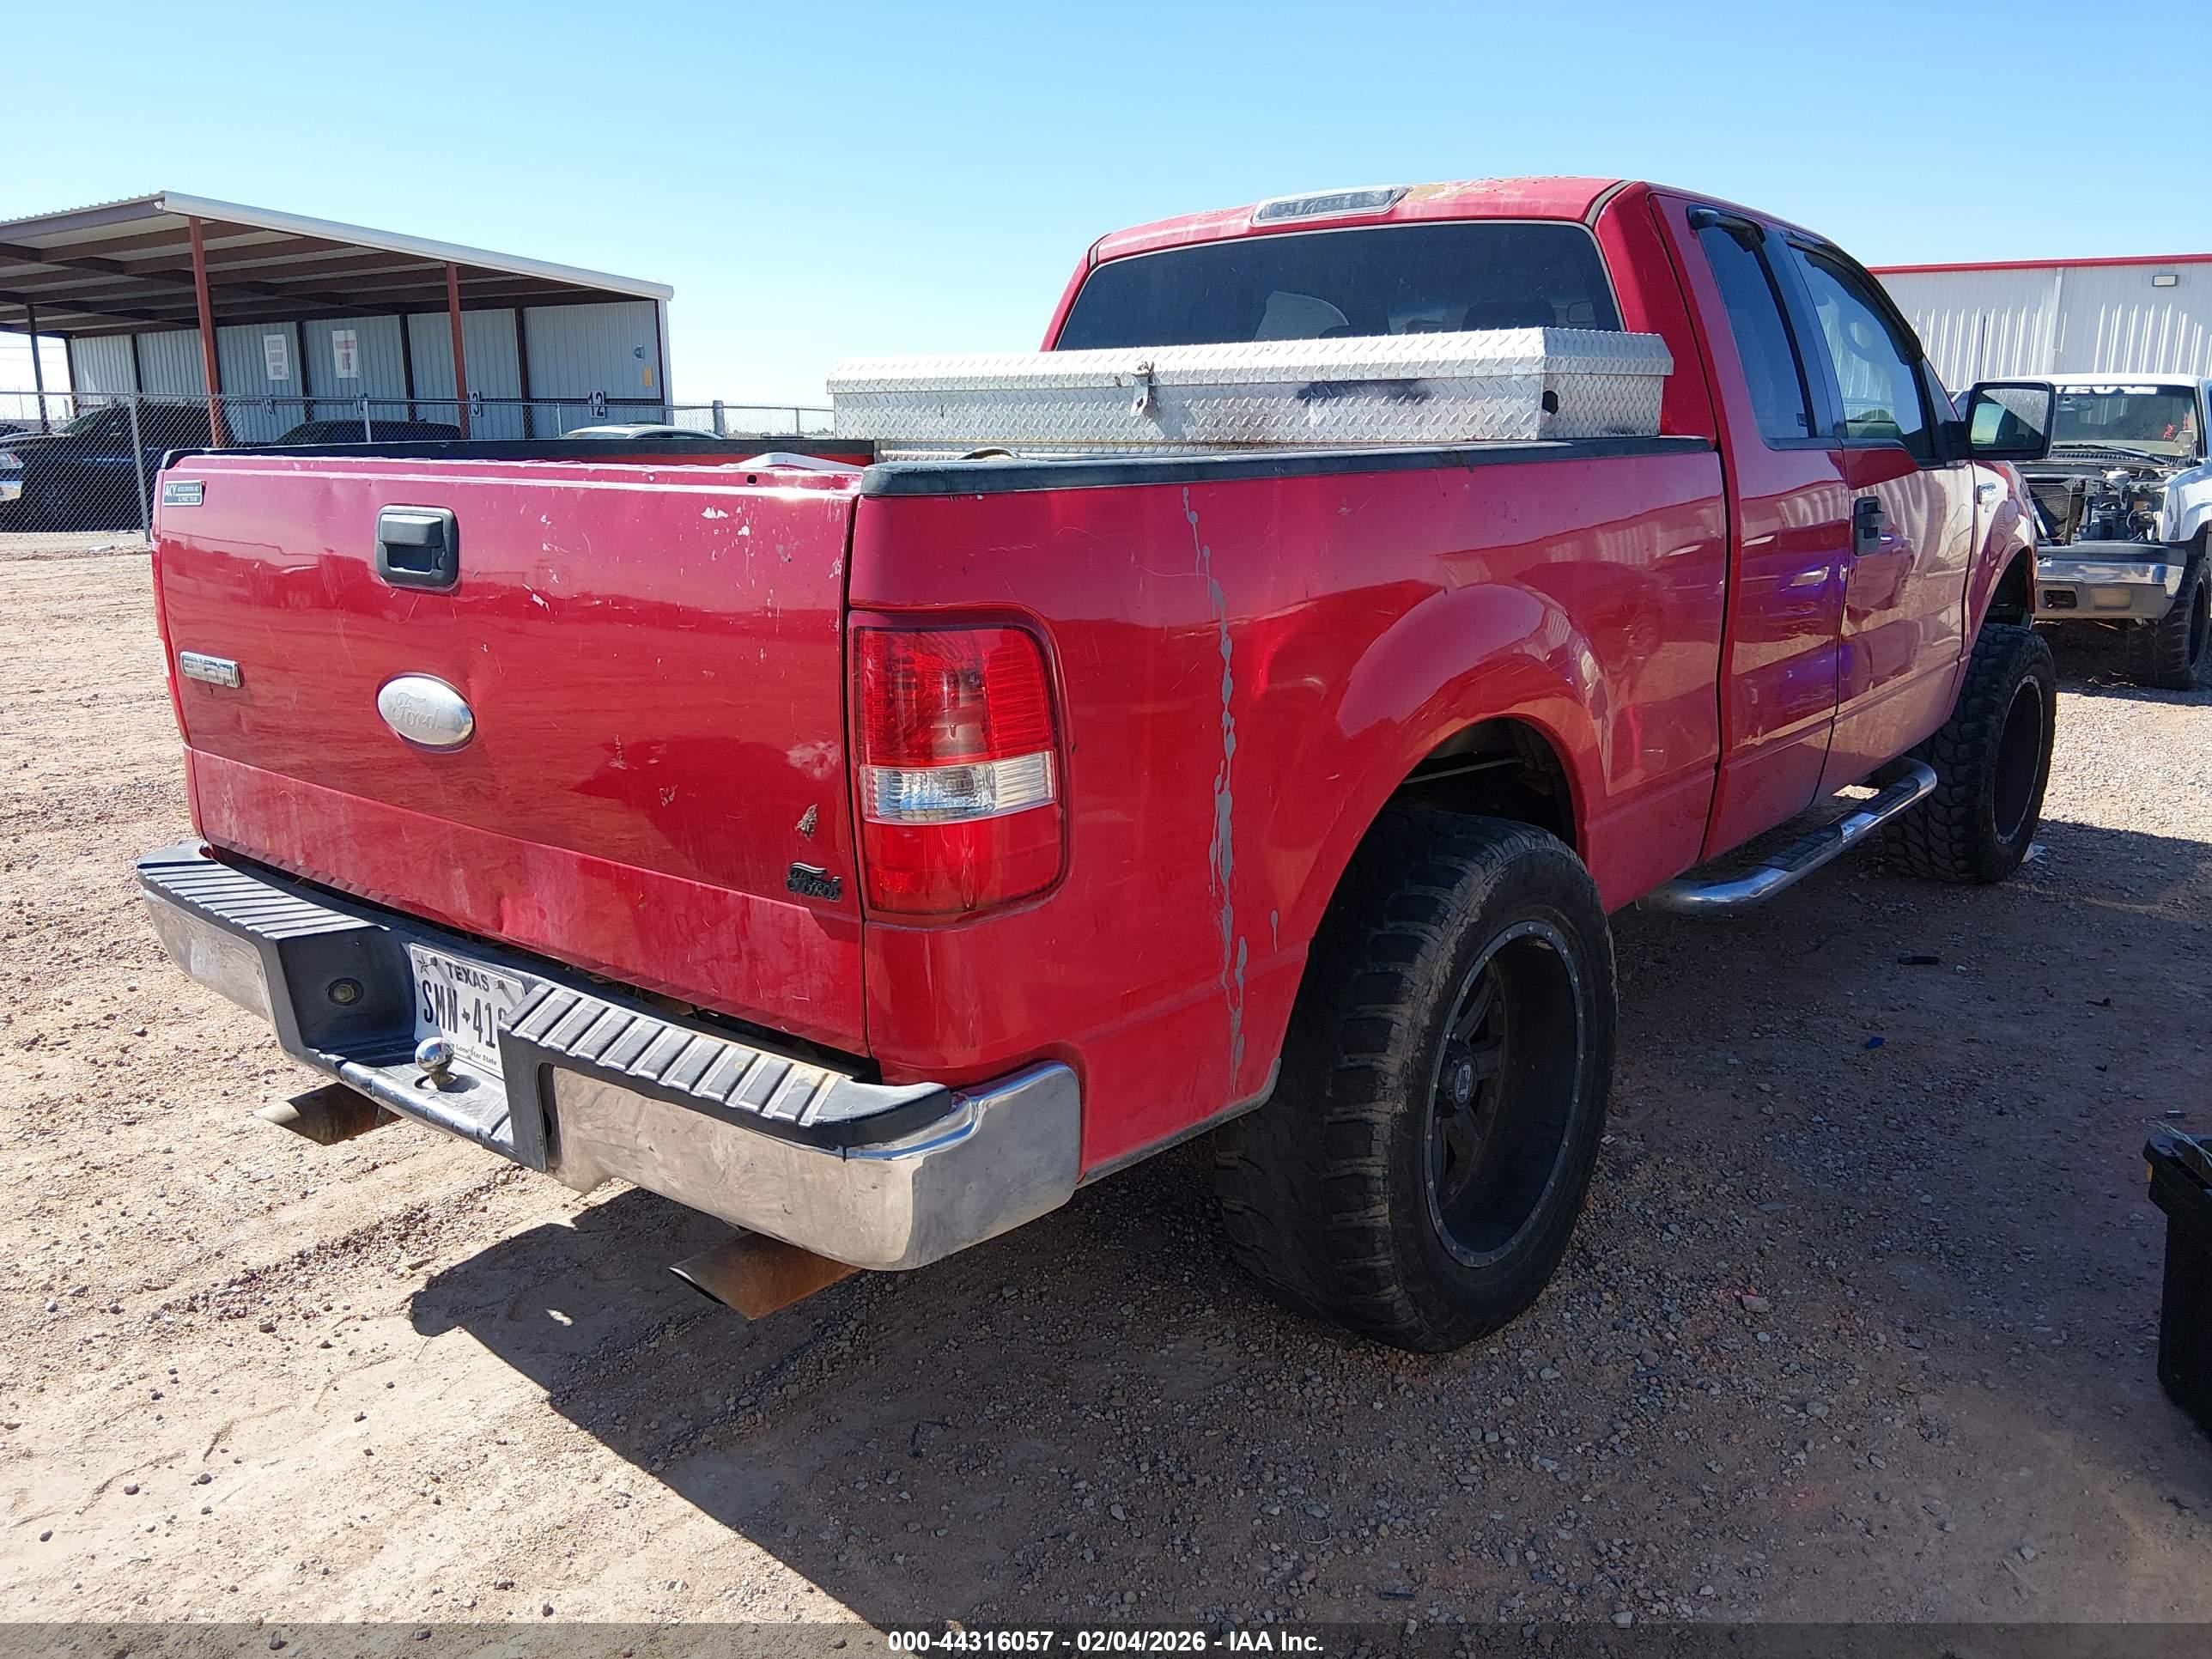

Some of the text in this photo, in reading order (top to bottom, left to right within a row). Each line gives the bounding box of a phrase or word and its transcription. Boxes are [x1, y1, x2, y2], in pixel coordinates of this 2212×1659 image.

[587, 392, 605, 417] 12
[445, 962, 490, 993] TEXAS
[422, 979, 459, 1034] SMN
